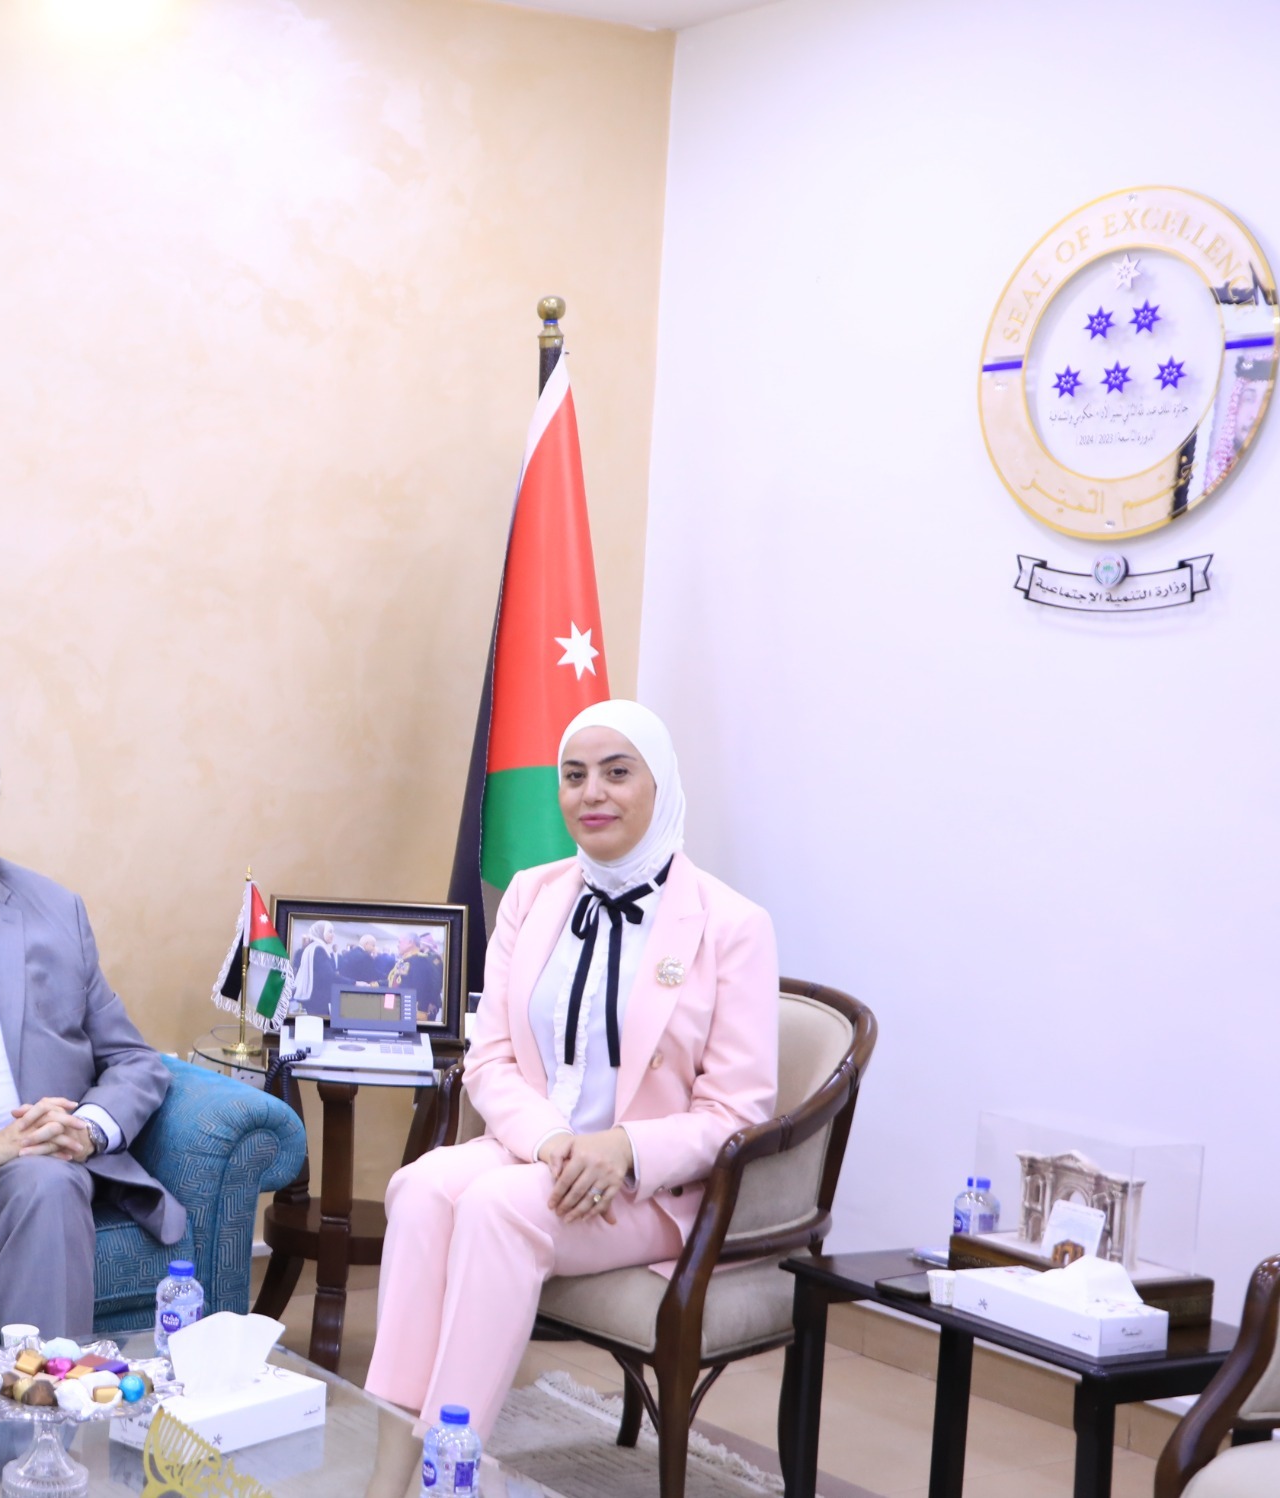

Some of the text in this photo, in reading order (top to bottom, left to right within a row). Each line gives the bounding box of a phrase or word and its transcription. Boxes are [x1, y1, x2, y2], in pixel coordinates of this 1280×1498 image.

[1002, 269, 1052, 344] SEAL
[1055, 225, 1091, 264] OF
[1105, 587, 1152, 607] التنمية
[1156, 580, 1187, 597] وزارة
